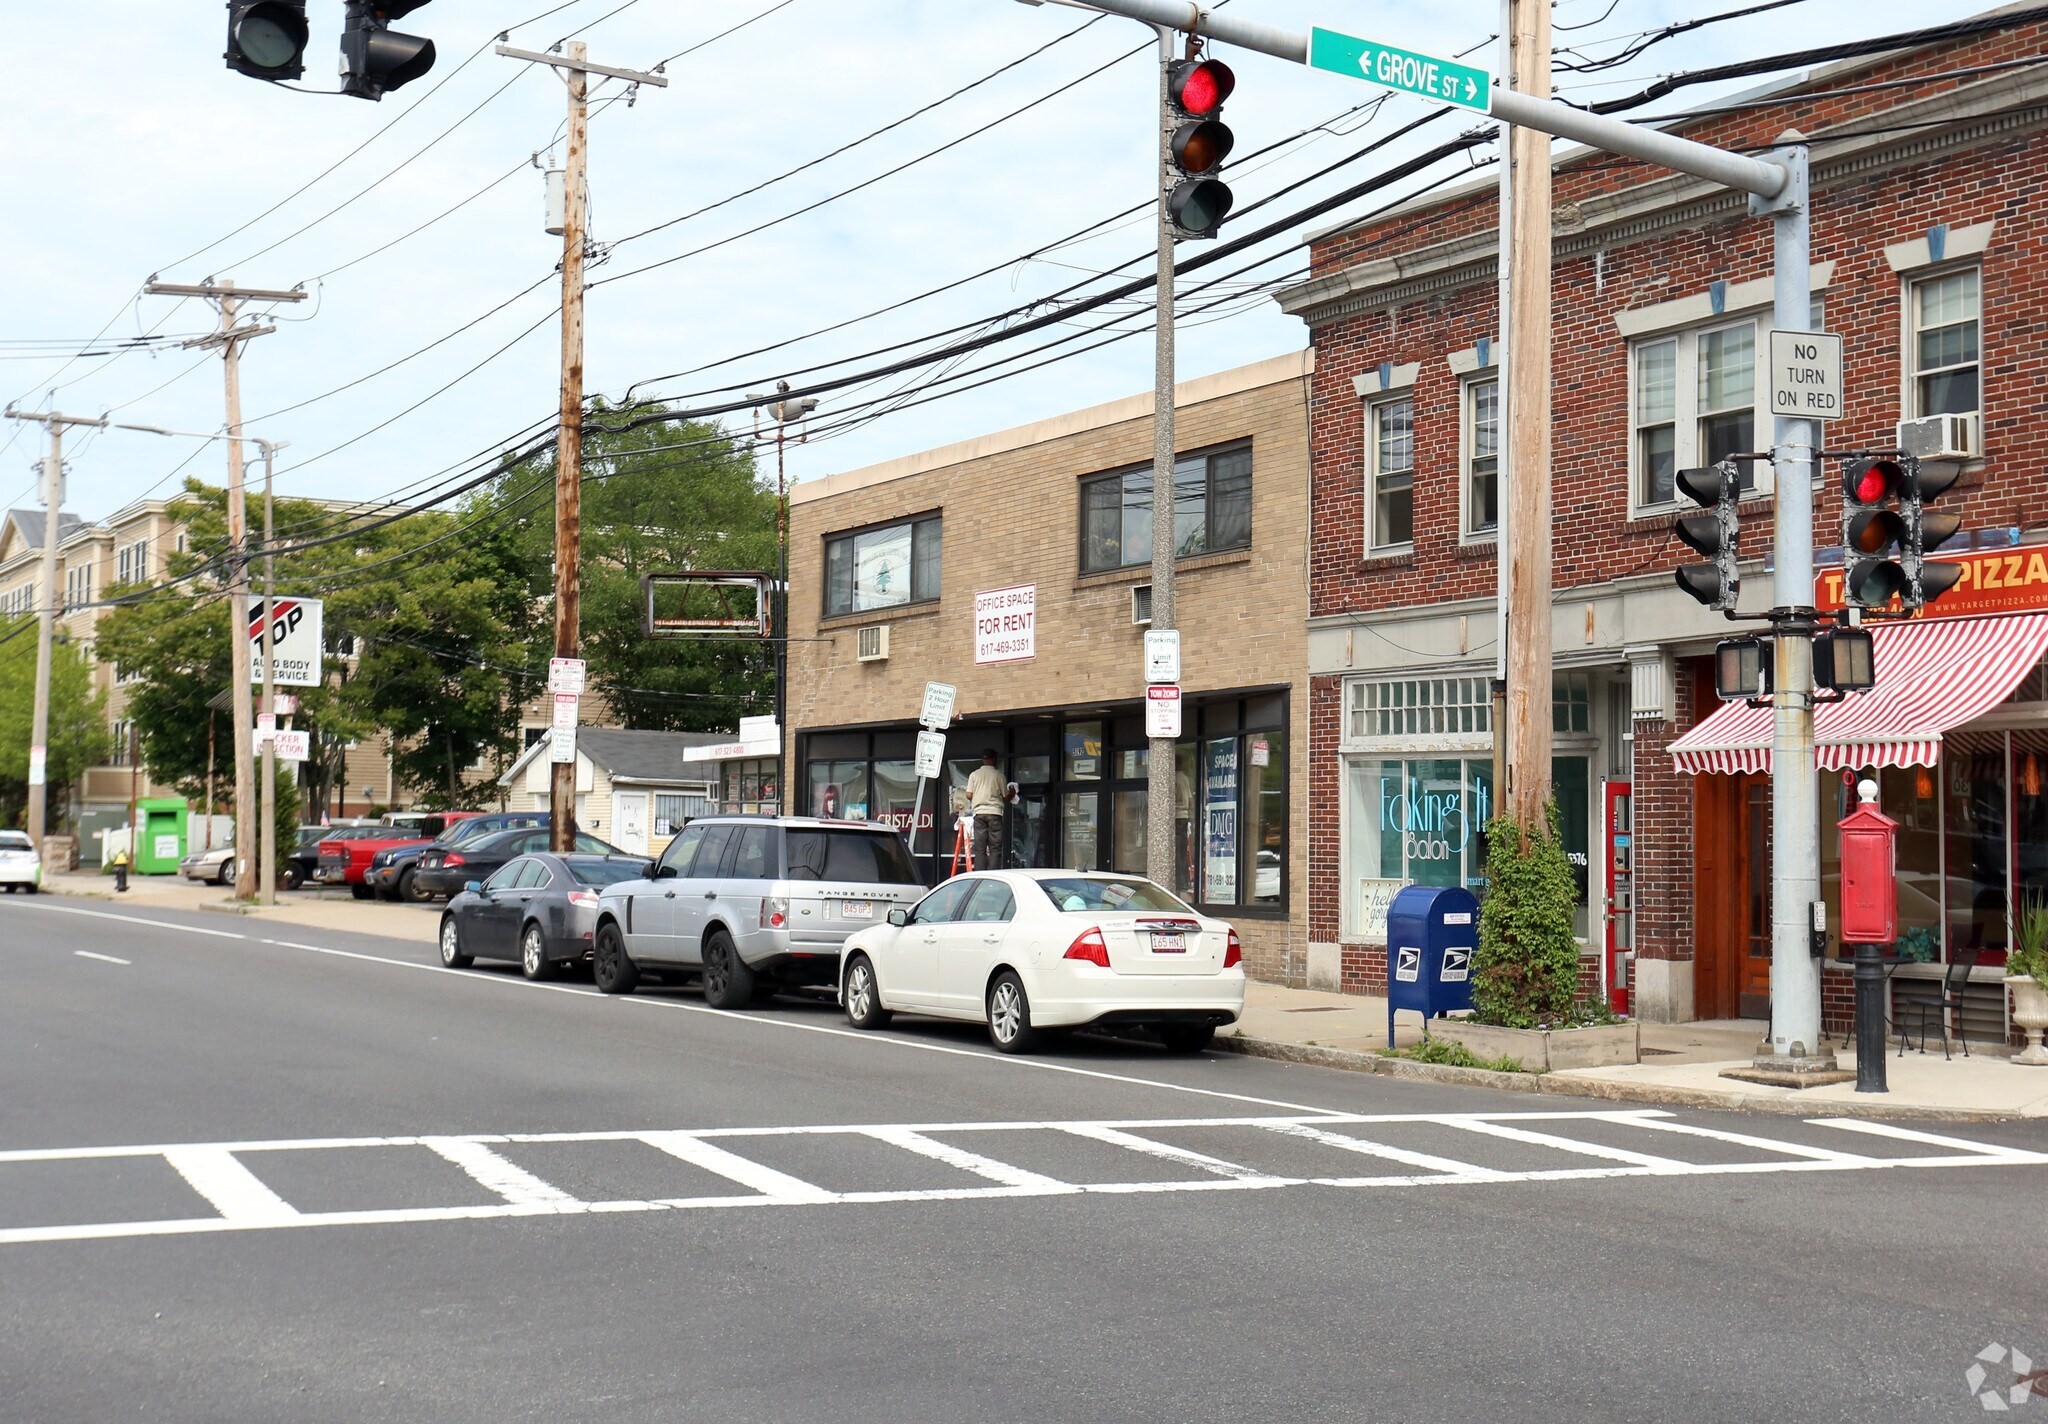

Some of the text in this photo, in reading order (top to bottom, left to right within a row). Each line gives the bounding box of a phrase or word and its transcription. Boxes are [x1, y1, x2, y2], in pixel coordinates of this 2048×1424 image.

[1377, 50, 1459, 98] GROVE ST
[1794, 343, 1817, 360] NO
[1786, 367, 1825, 384] TURN
[1777, 390, 1835, 409] ON RED
[1952, 552, 2048, 593] PIZZA
[977, 591, 1034, 612] OFFICE SPACE
[978, 612, 1033, 636] FOR RENT
[981, 638, 1029, 656] 617-469-3351
[1148, 636, 1176, 645] Parking
[283, 660, 310, 670] BODY
[272, 670, 309, 680] ERVICE
[928, 687, 953, 698] Parking
[1150, 689, 1178, 698] TOW ZONE
[920, 737, 942, 747] Parking
[1215, 754, 1234, 768] SPACE
[1380, 776, 1488, 853] Faking It
[1405, 832, 1449, 860] Salon
[1153, 937, 1168, 948] 165
